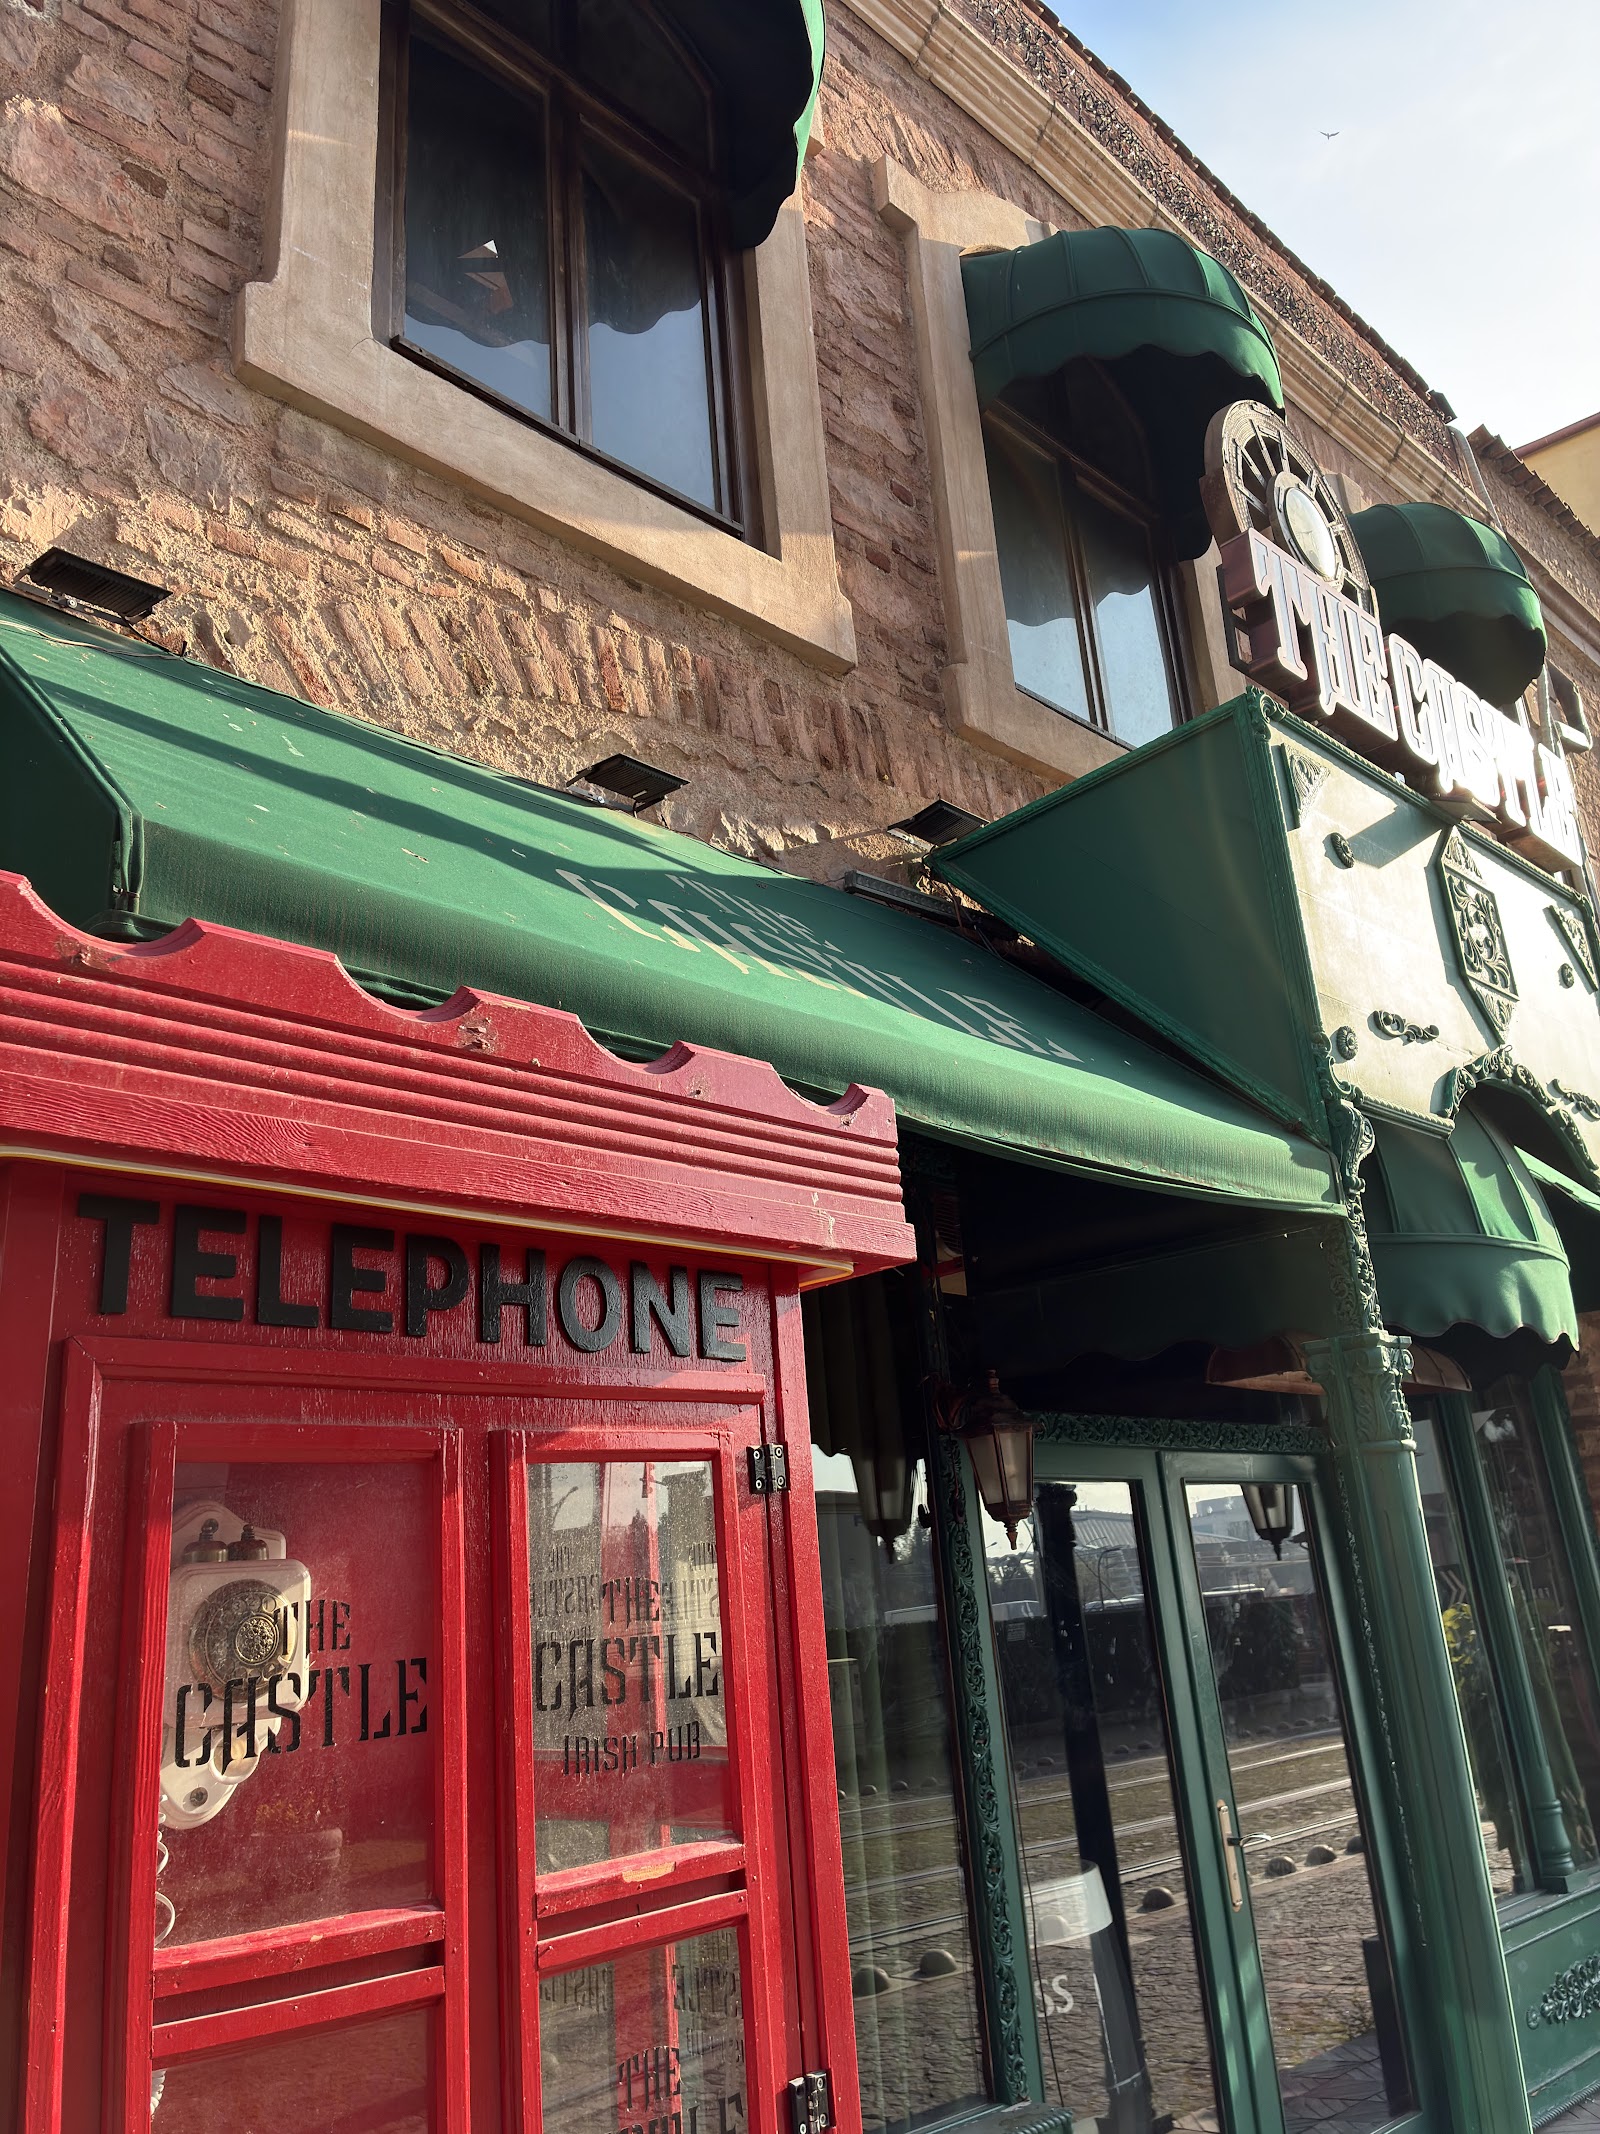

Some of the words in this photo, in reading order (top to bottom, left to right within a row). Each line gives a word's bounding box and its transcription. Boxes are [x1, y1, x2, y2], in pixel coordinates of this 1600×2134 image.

[1248, 527, 1398, 741] THE
[665, 873, 843, 954] THE
[555, 868, 1084, 1063] CASTLE
[77, 1193, 747, 1362] TELEPHONE
[273, 1600, 350, 1655] THE
[602, 1577, 661, 1627] THE
[175, 1658, 428, 1775] CASTLE
[535, 1632, 719, 1721] CASTLE
[564, 1734, 637, 1776] IRISH
[650, 1721, 701, 1766] PUB
[619, 2046, 681, 2113] THE
